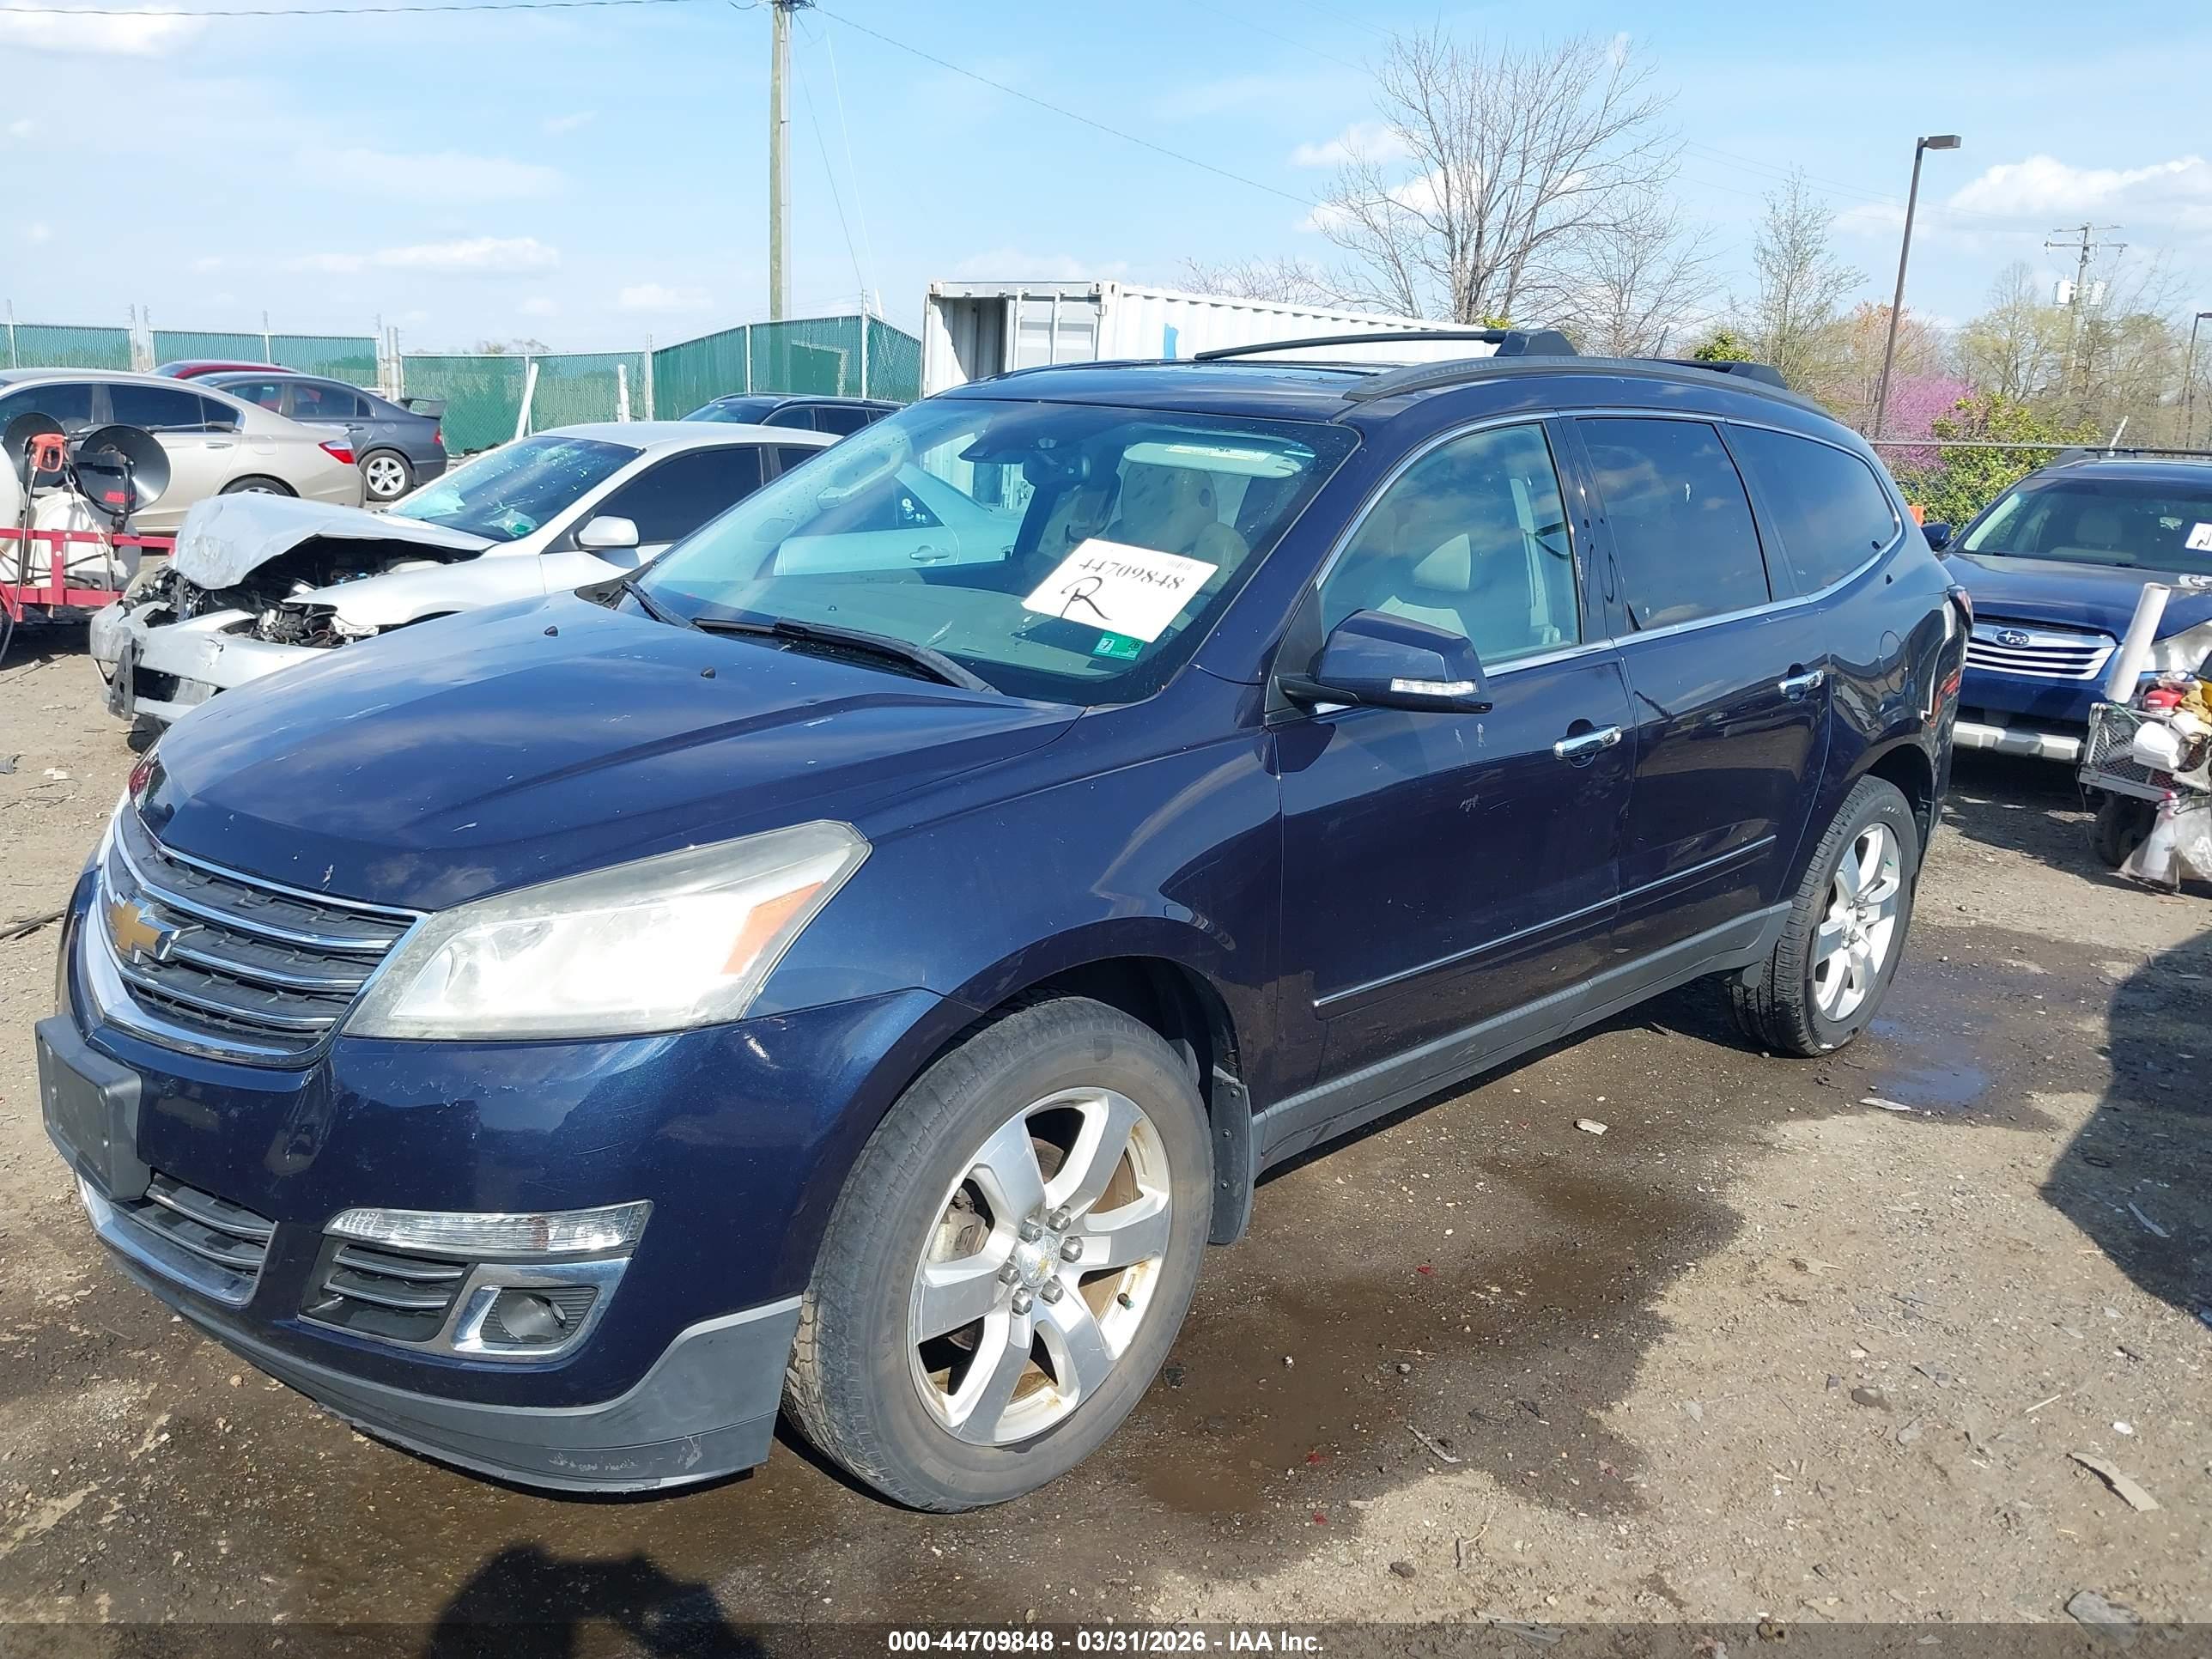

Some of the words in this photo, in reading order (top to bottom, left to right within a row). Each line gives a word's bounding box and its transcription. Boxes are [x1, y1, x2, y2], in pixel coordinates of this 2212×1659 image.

[1079, 558, 1185, 590] 44709848
[1060, 576, 1113, 621] R
[1103, 640, 1112, 649] 7
[1127, 640, 1140, 649] 26
